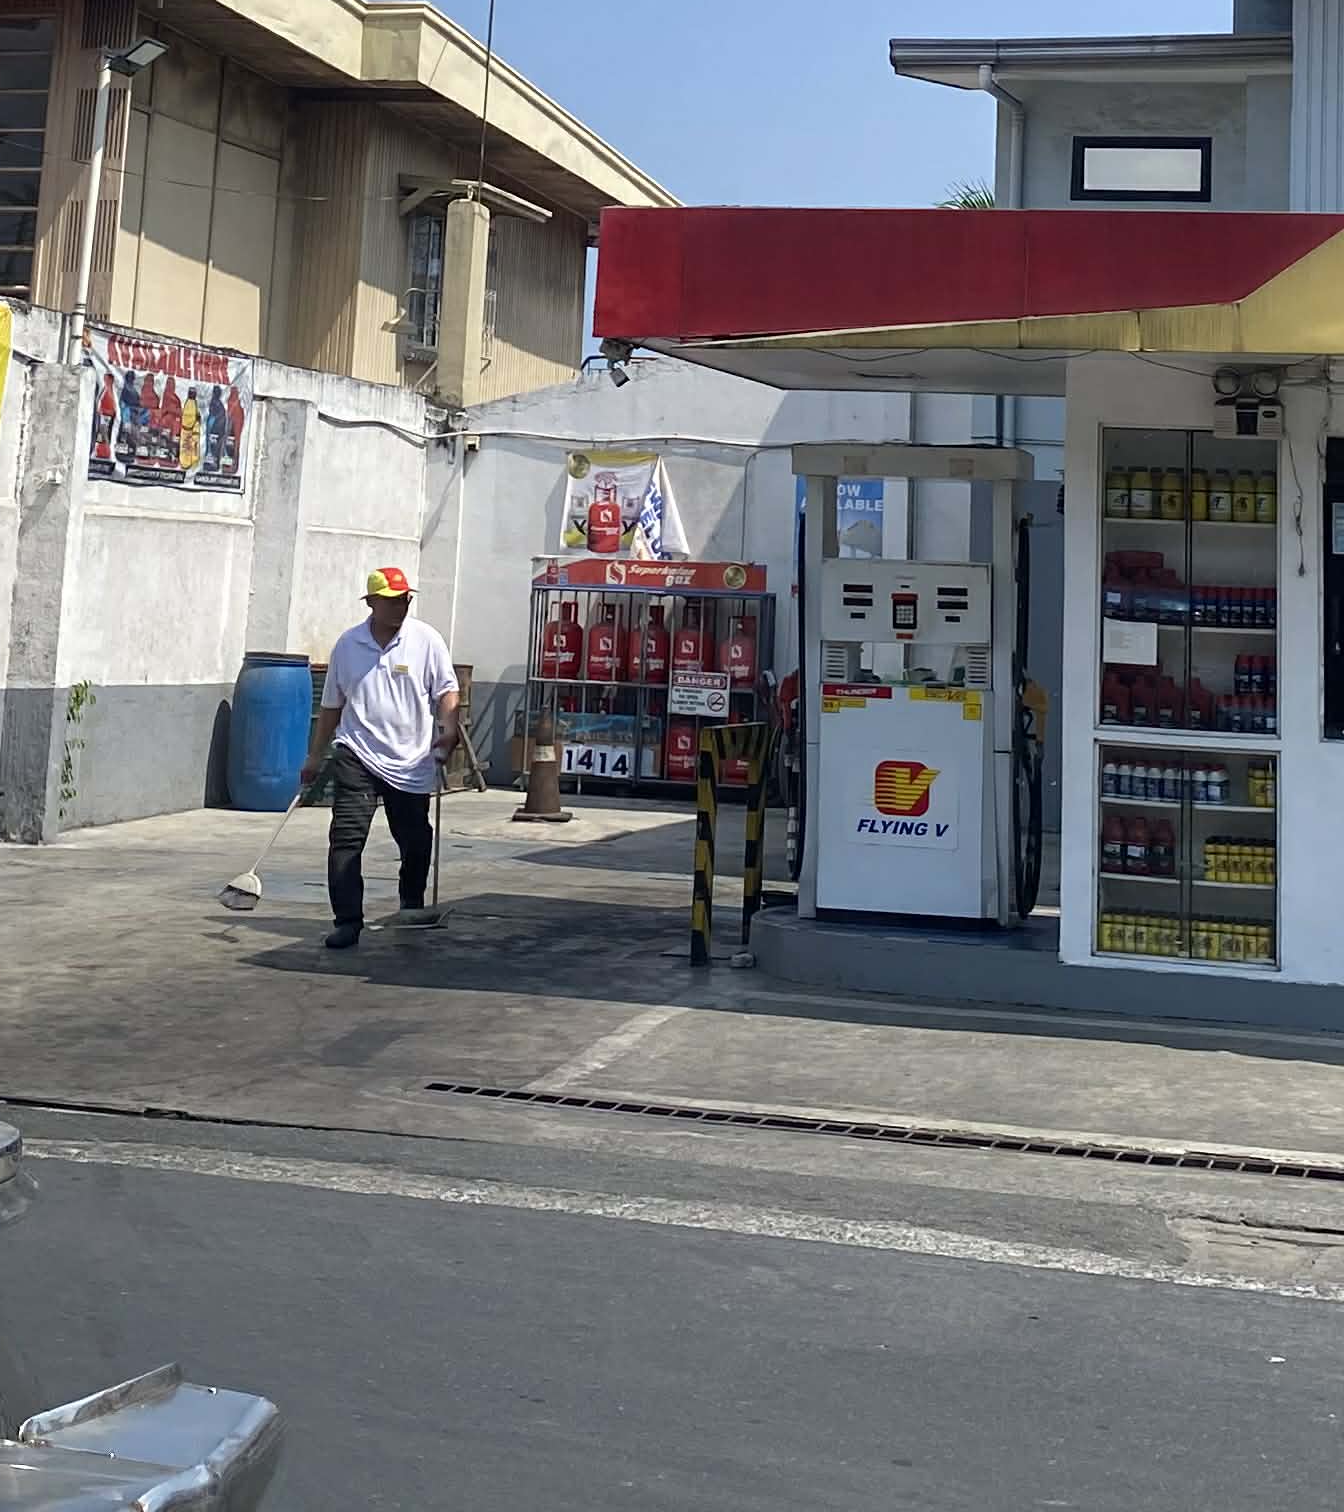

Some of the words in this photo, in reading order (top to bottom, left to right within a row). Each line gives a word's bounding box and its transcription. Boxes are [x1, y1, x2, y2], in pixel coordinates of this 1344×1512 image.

[837, 483, 862, 497] OW
[856, 818, 929, 837] FLYING
[933, 822, 950, 838] V
